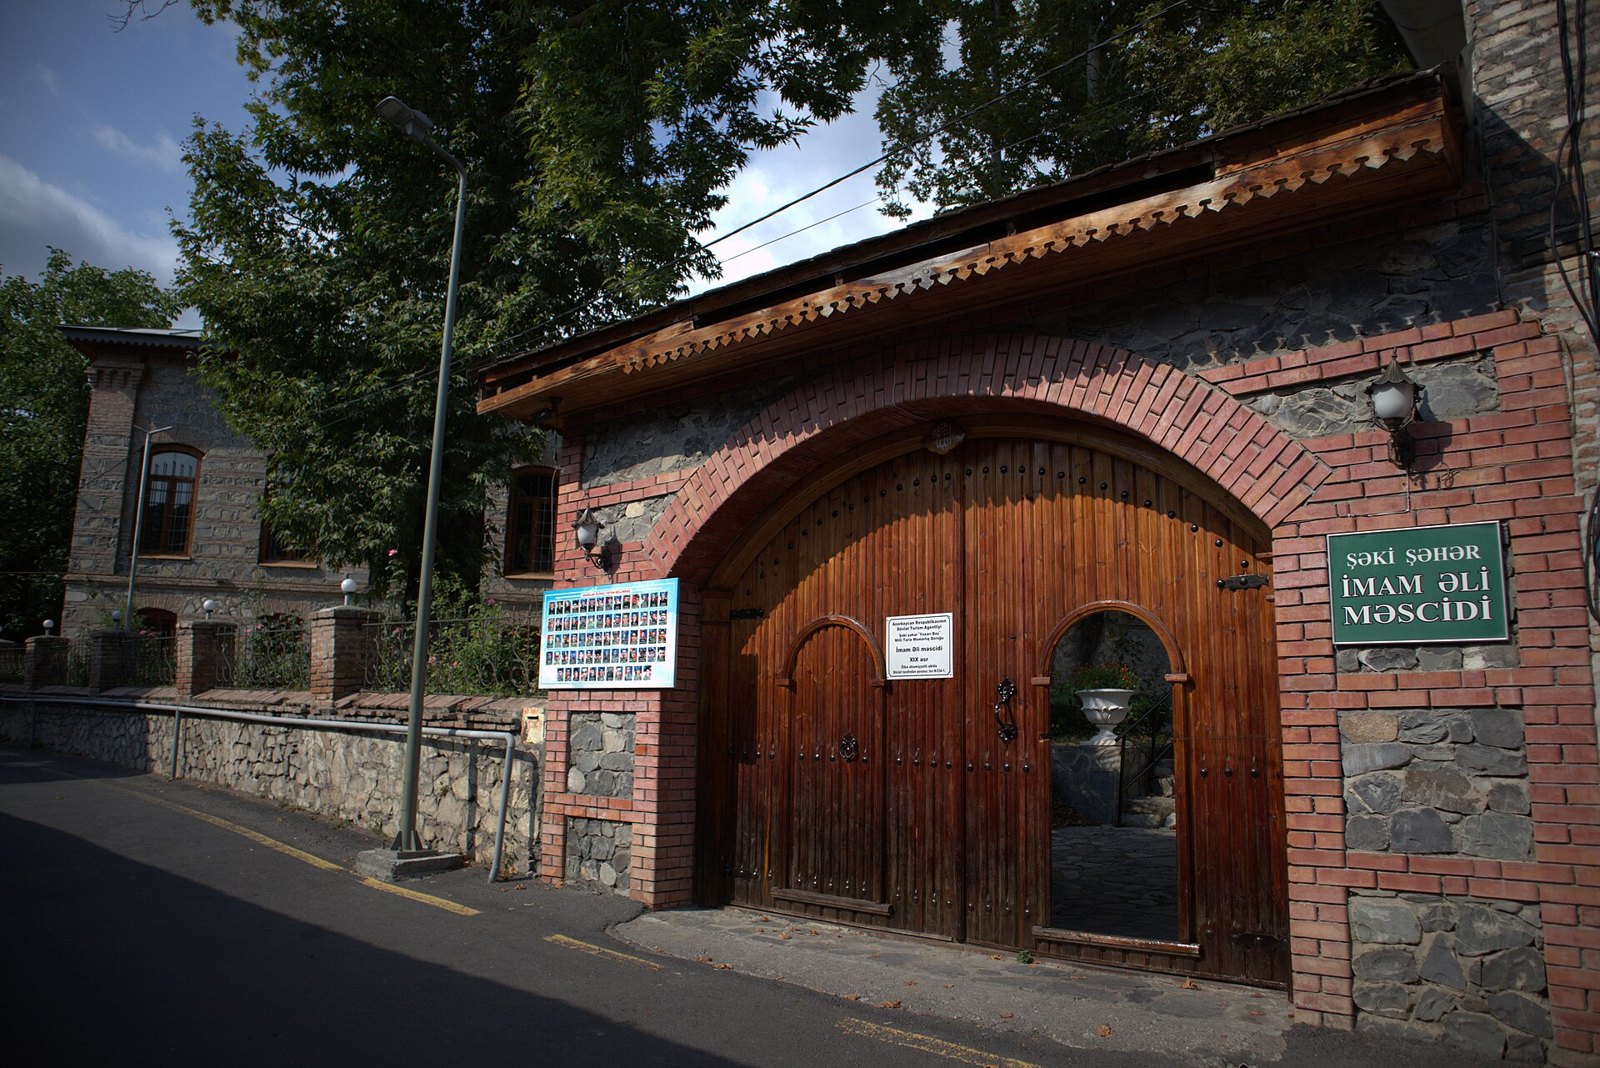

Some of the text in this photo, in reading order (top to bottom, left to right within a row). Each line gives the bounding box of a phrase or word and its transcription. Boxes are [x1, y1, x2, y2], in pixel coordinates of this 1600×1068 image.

[1347, 545, 1481, 570] ŞƏKİ ŞƏHƏR
[1341, 566, 1491, 598] İMAM ƏLİ
[1343, 595, 1493, 625] MƏSCİDİ
